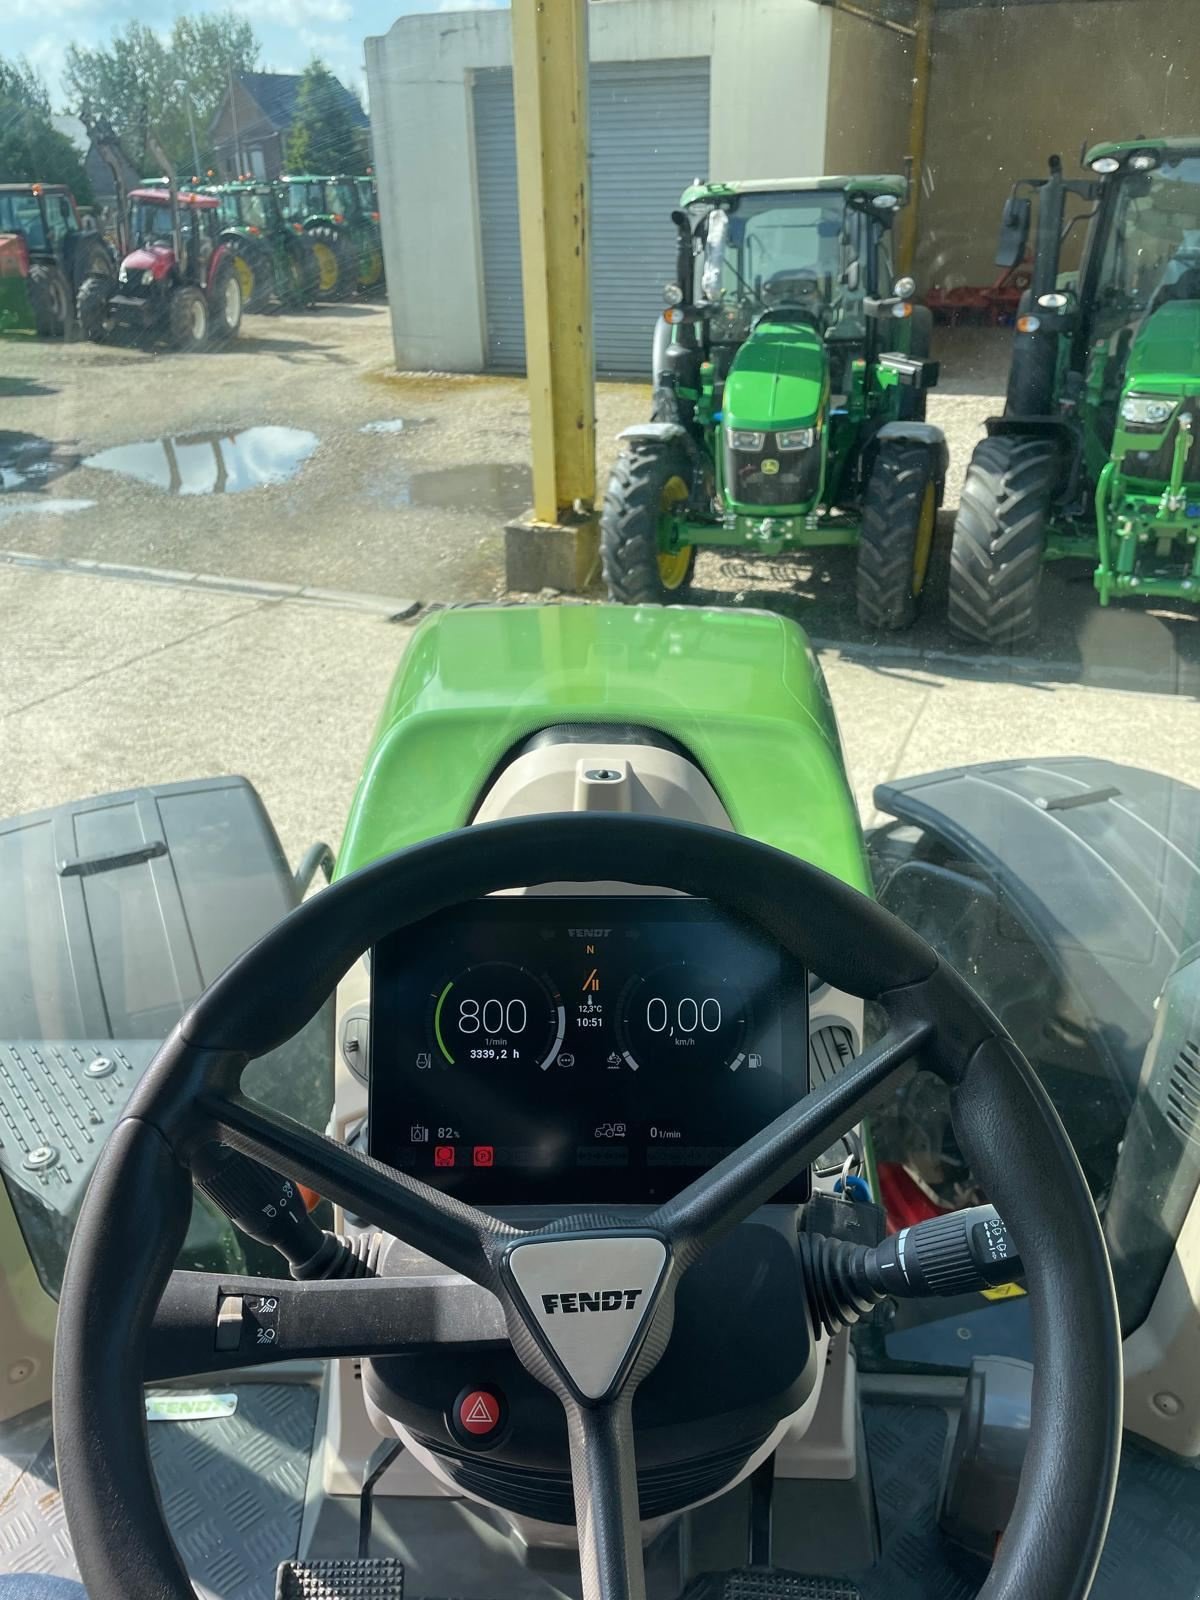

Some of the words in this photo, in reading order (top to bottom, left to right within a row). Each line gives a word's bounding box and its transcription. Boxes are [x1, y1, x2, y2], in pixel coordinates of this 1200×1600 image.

[568, 928, 612, 937] FENDT
[586, 945, 594, 954] N
[458, 999, 527, 1034] 800
[646, 997, 722, 1037] 0,00
[577, 1018, 602, 1027] 10:51
[485, 1038, 508, 1046] 1/min
[675, 1038, 695, 1046] km/h
[470, 1049, 508, 1060] 3339,2
[513, 1048, 520, 1059] h
[659, 1130, 681, 1138] 1/min
[260, 1297, 265, 1307] 1
[541, 1289, 643, 1315] FENDT
[257, 1328, 264, 1337] 2
